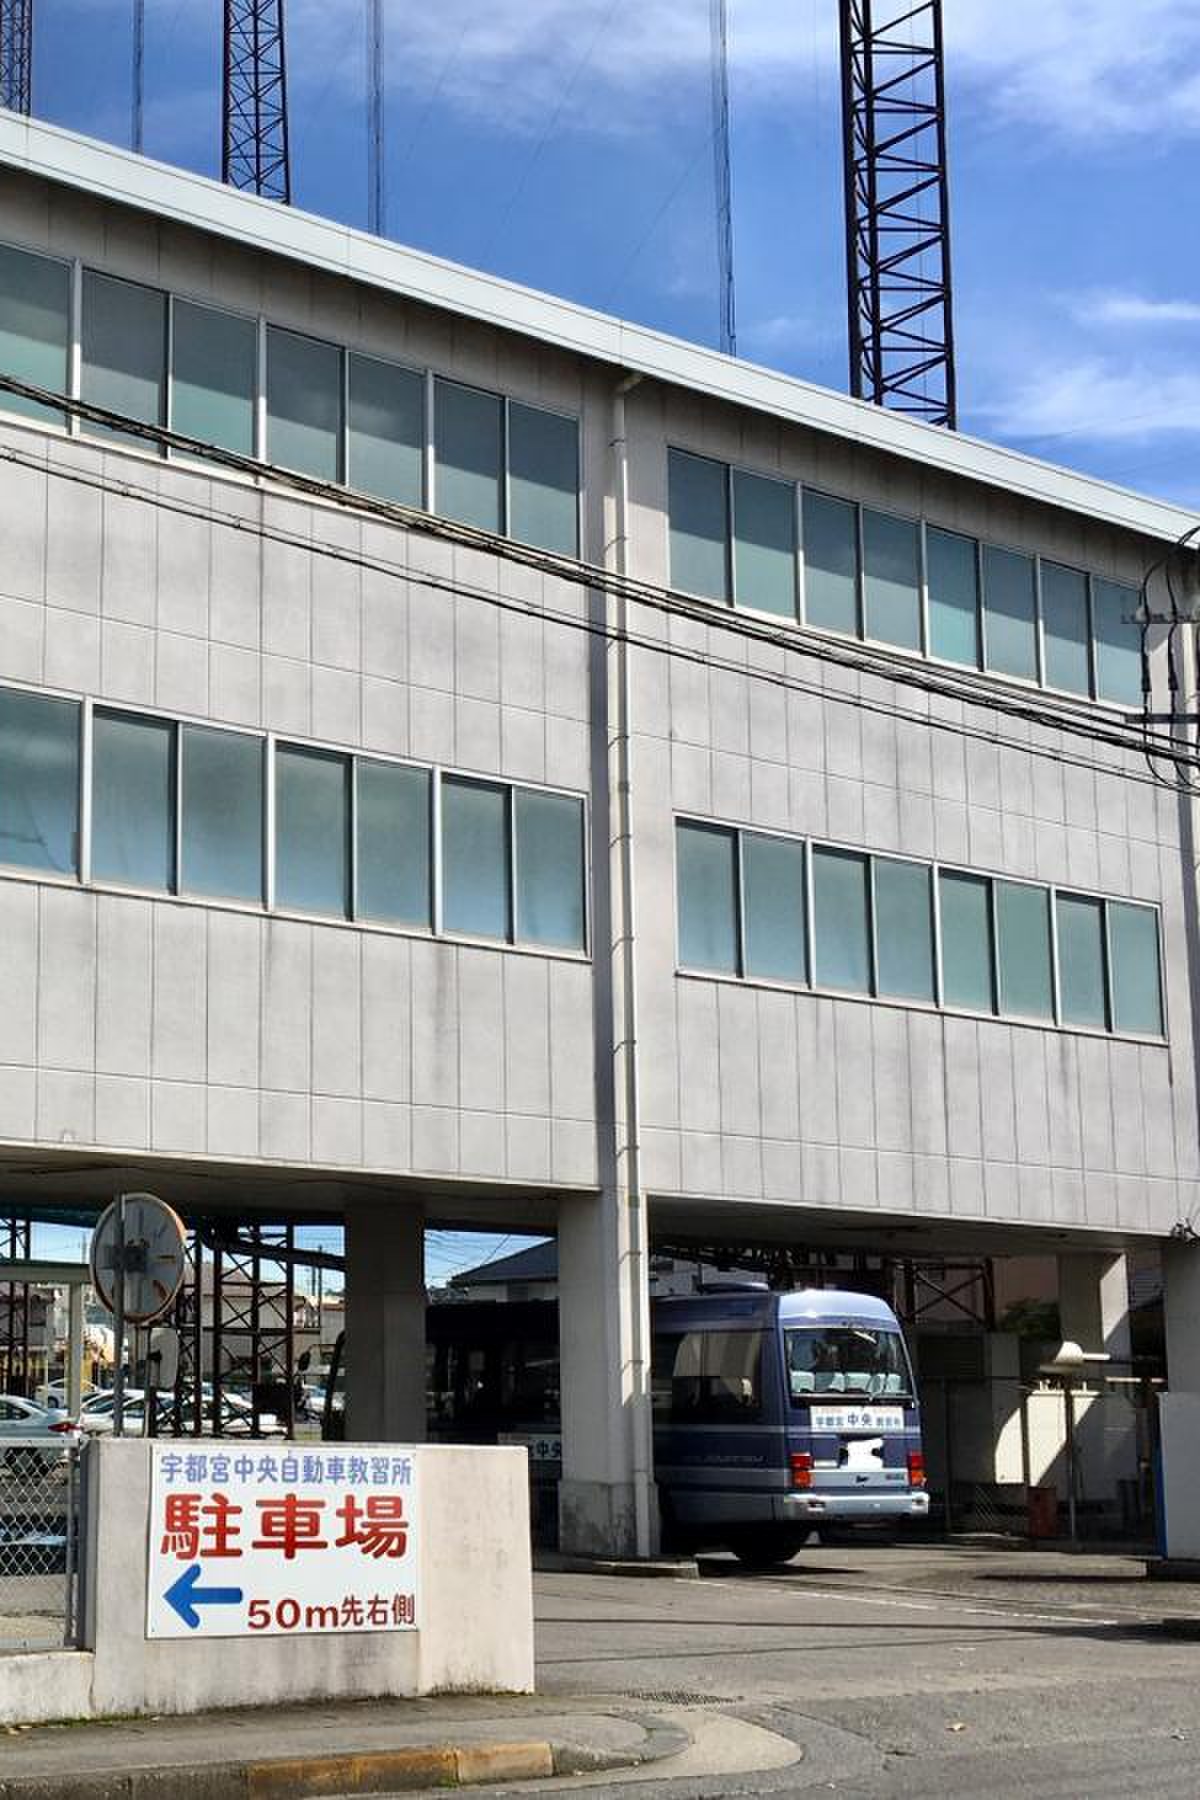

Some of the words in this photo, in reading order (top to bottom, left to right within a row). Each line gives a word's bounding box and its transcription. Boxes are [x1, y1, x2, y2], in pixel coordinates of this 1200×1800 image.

[161, 1453, 412, 1486] 宇都宮中央自動車教習所
[160, 1493, 410, 1560] 駐車場
